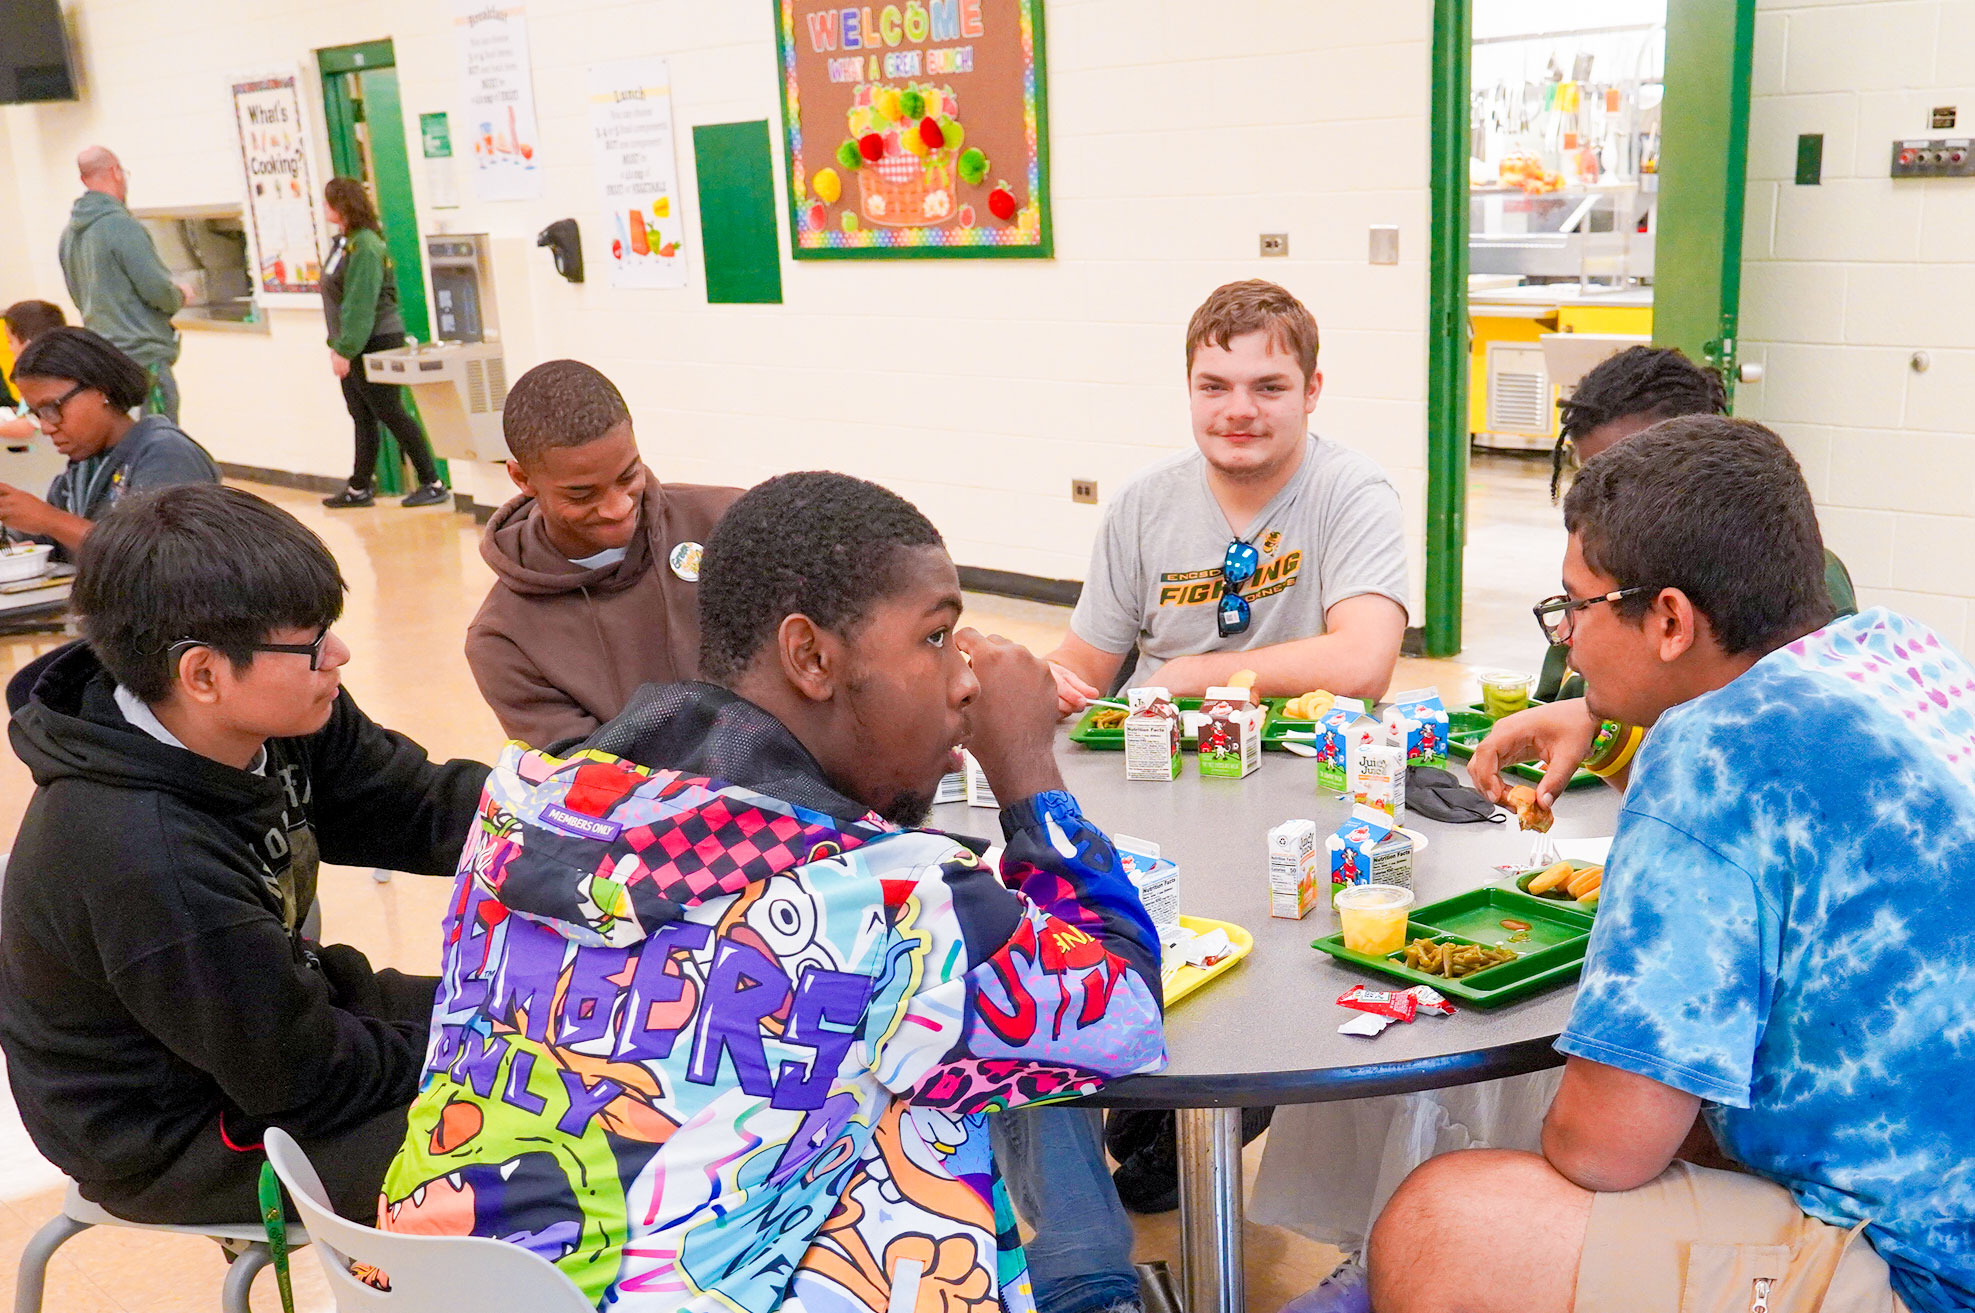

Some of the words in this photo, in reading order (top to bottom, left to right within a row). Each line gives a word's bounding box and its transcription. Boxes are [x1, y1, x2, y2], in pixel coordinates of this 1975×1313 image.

[806, 0, 985, 53] WELCOME
[828, 56, 865, 83] WHAT
[868, 54, 881, 80] A
[884, 50, 922, 78] GREAT
[926, 45, 974, 75] BUNCH!
[613, 85, 647, 103] Lunch
[247, 102, 289, 124] What's
[251, 137, 304, 179] Cooking?
[1359, 756, 1388, 769] Juicy
[548, 808, 593, 831] MEMBERS
[591, 823, 614, 835] ONLY
[1374, 854, 1396, 863] Nutrition
[1142, 883, 1163, 893] Nutrition
[1164, 878, 1176, 886] Facts
[428, 1022, 628, 1139] ONLY
